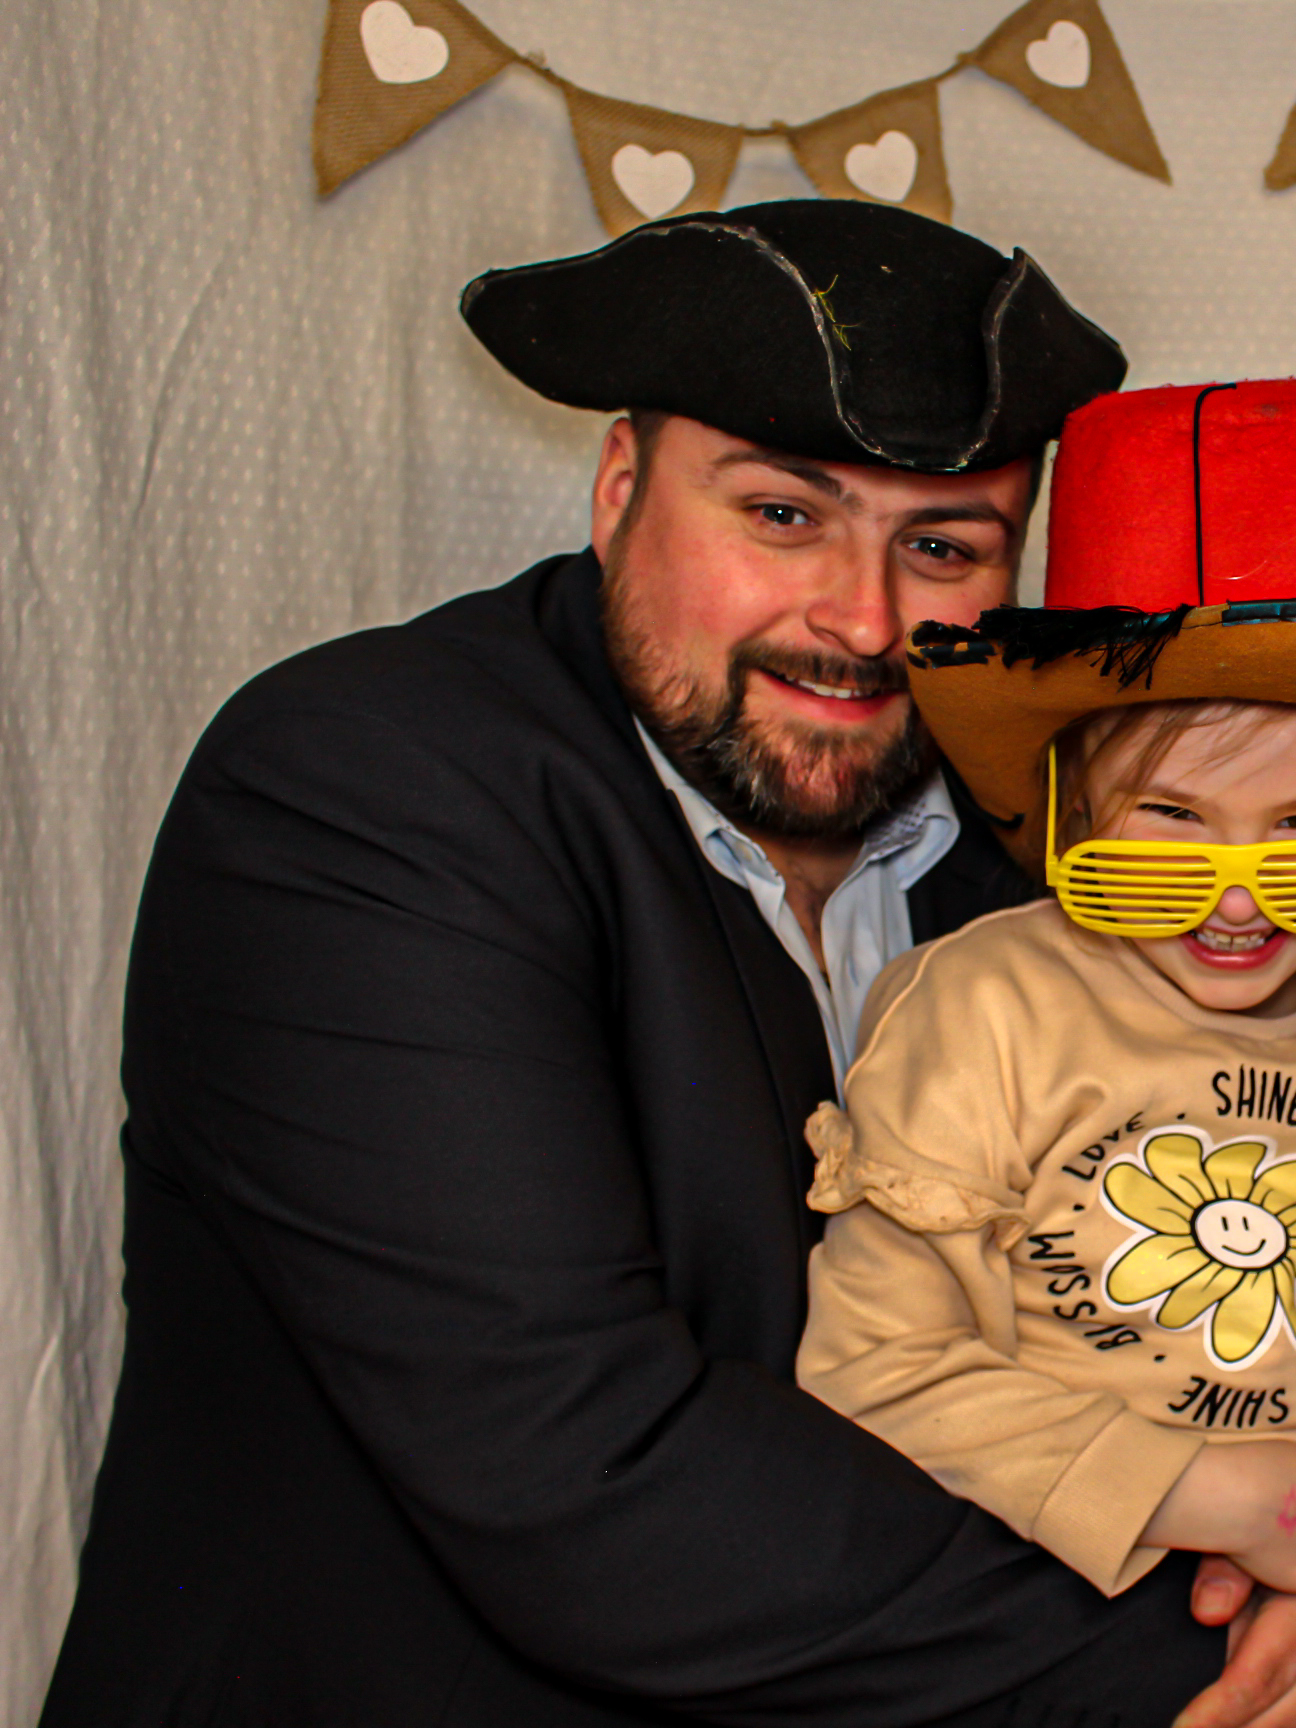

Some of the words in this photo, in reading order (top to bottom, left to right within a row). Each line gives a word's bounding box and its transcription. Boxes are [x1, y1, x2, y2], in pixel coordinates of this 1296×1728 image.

[1062, 1111, 1145, 1181] LOVE
[1028, 1230, 1142, 1350] BLSSOM
[1167, 1375, 1289, 1428] SHINE
